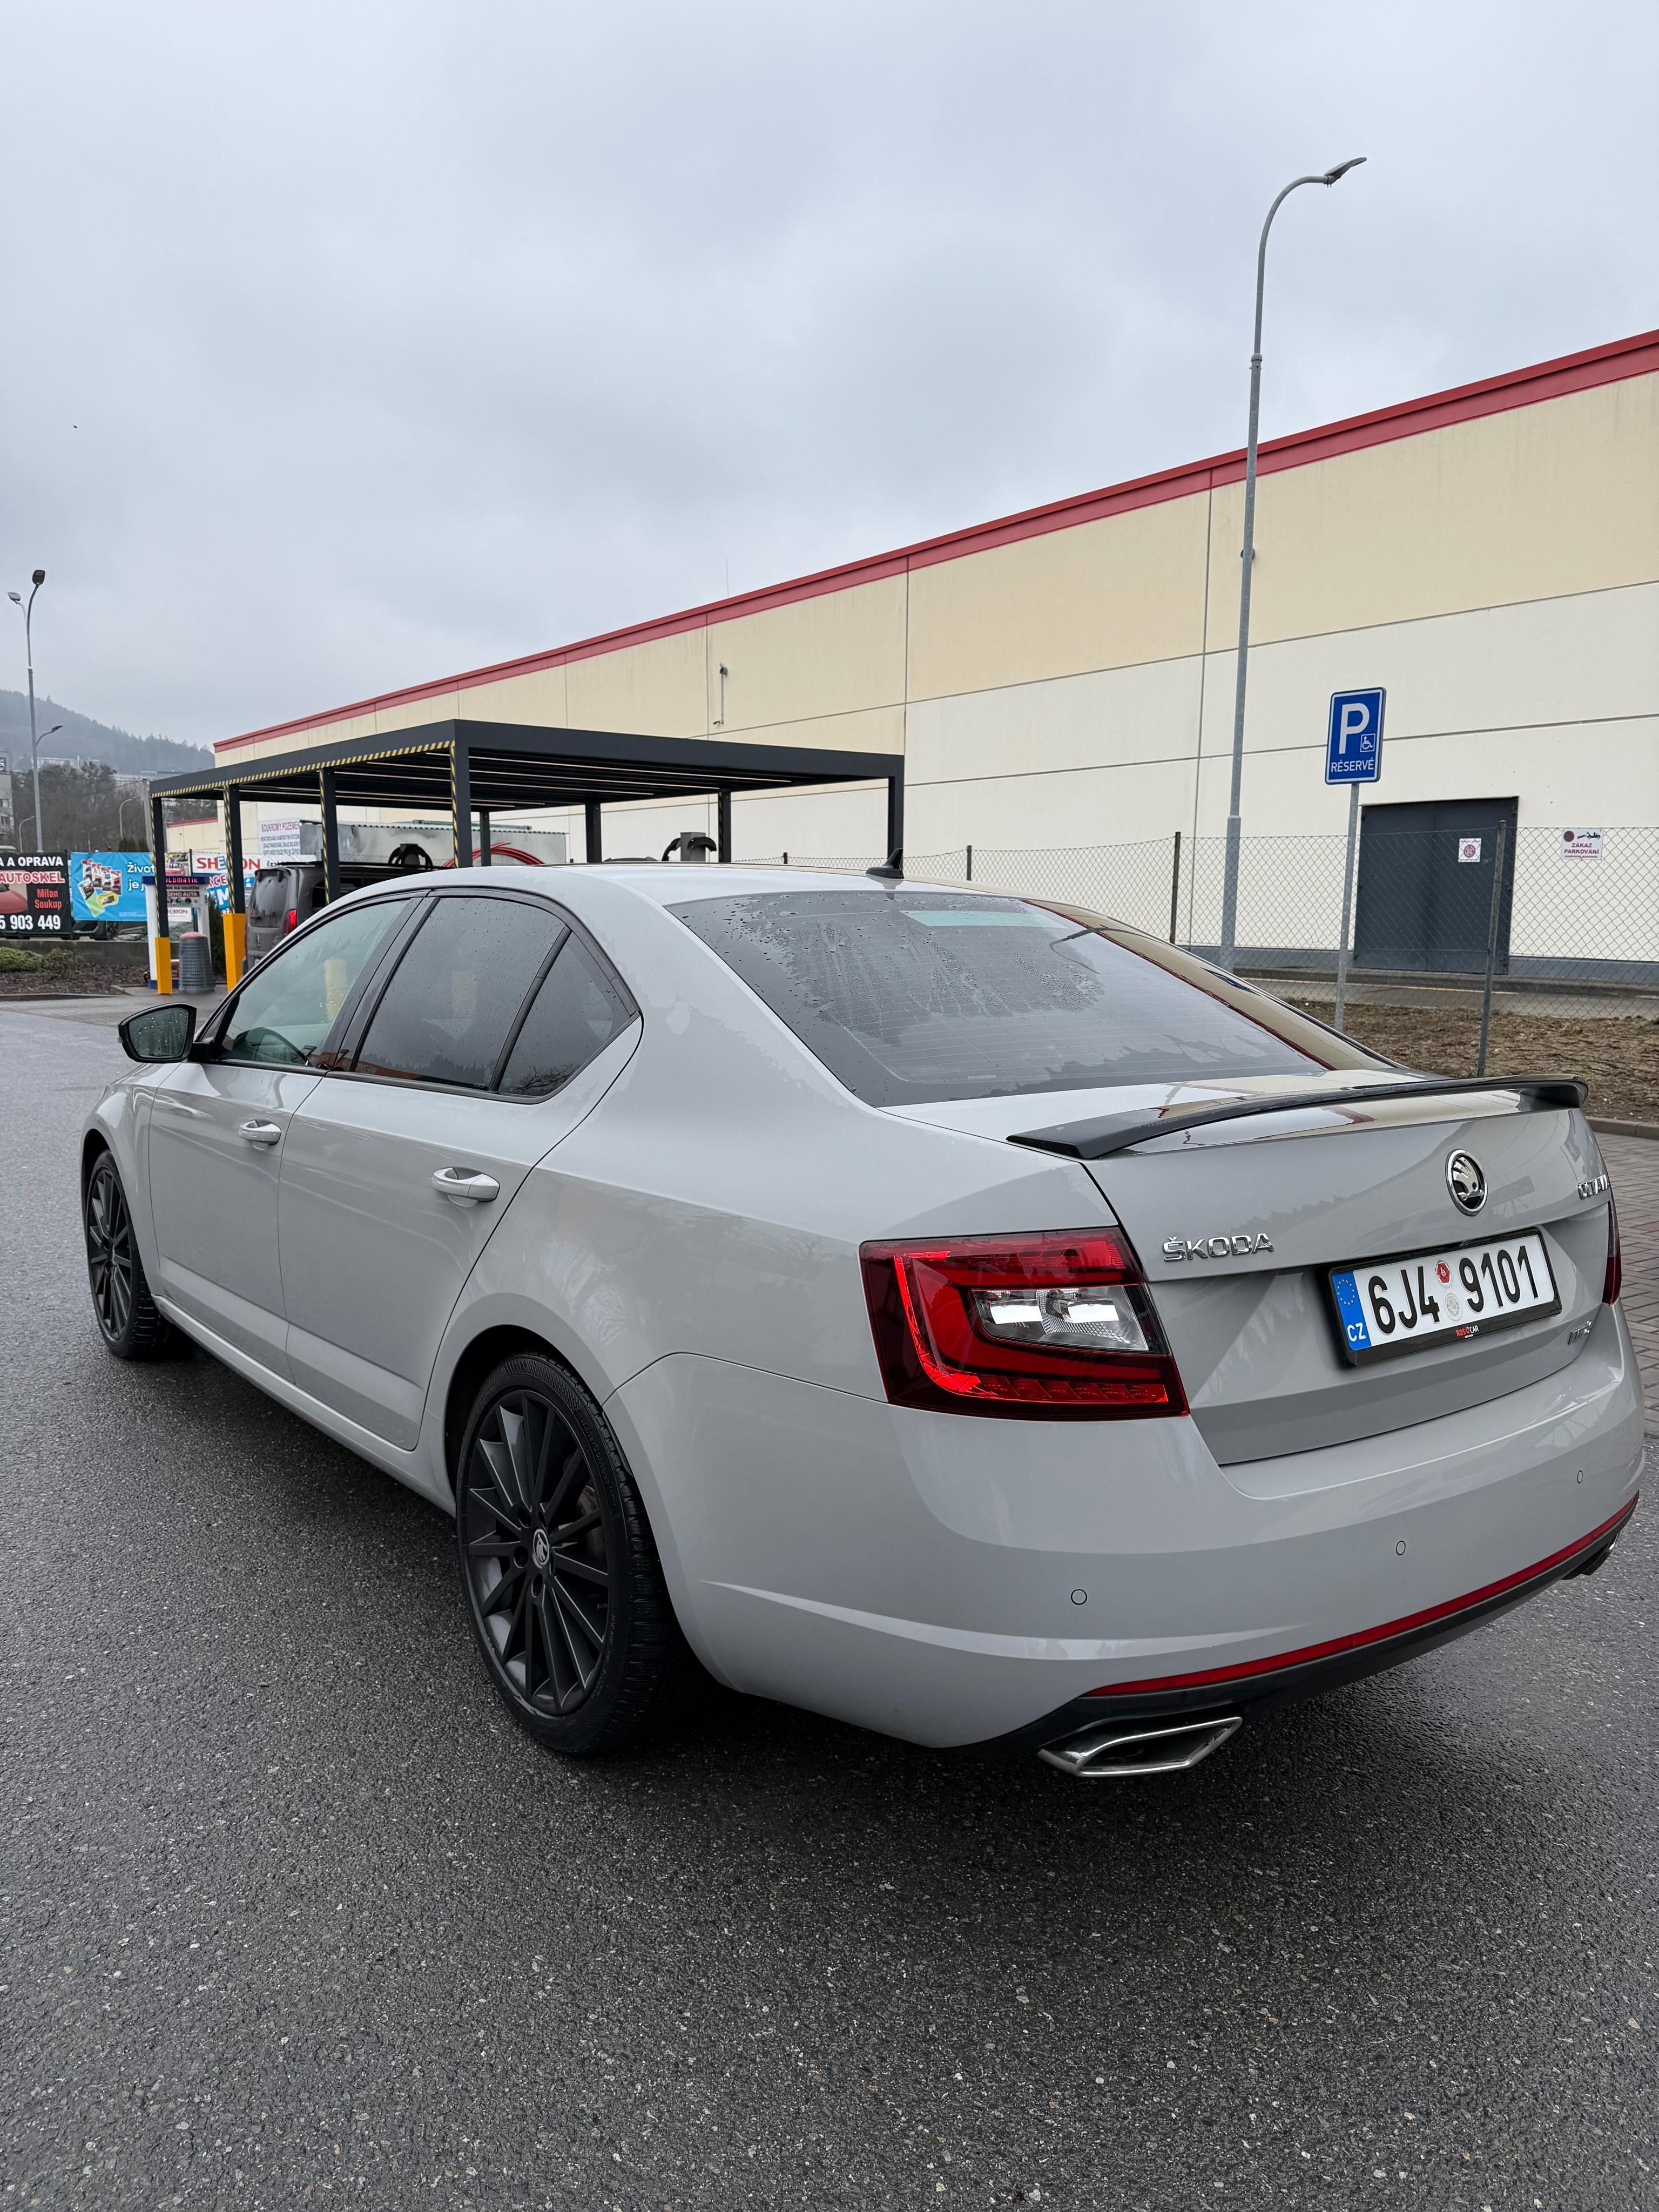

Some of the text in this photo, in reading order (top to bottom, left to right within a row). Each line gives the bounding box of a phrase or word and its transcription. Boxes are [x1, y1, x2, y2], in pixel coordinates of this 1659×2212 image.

[1339, 703, 1370, 754] P
[1331, 757, 1374, 773] RÉSERVÉ
[6, 857, 16, 867] A
[17, 856, 64, 867] OPRAVA
[197, 855, 260, 871] SHEON
[0, 872, 64, 884] AUTOSKEL
[128, 879, 139, 891] je
[37, 889, 58, 898] Milan
[35, 900, 62, 910] Soukup
[10, 915, 33, 930] 903
[37, 915, 61, 930] 449
[1163, 1236, 1274, 1262] ŠKODA
[1368, 1245, 1539, 1334] 6J4 9101
[1347, 1323, 1366, 1342] CZ
